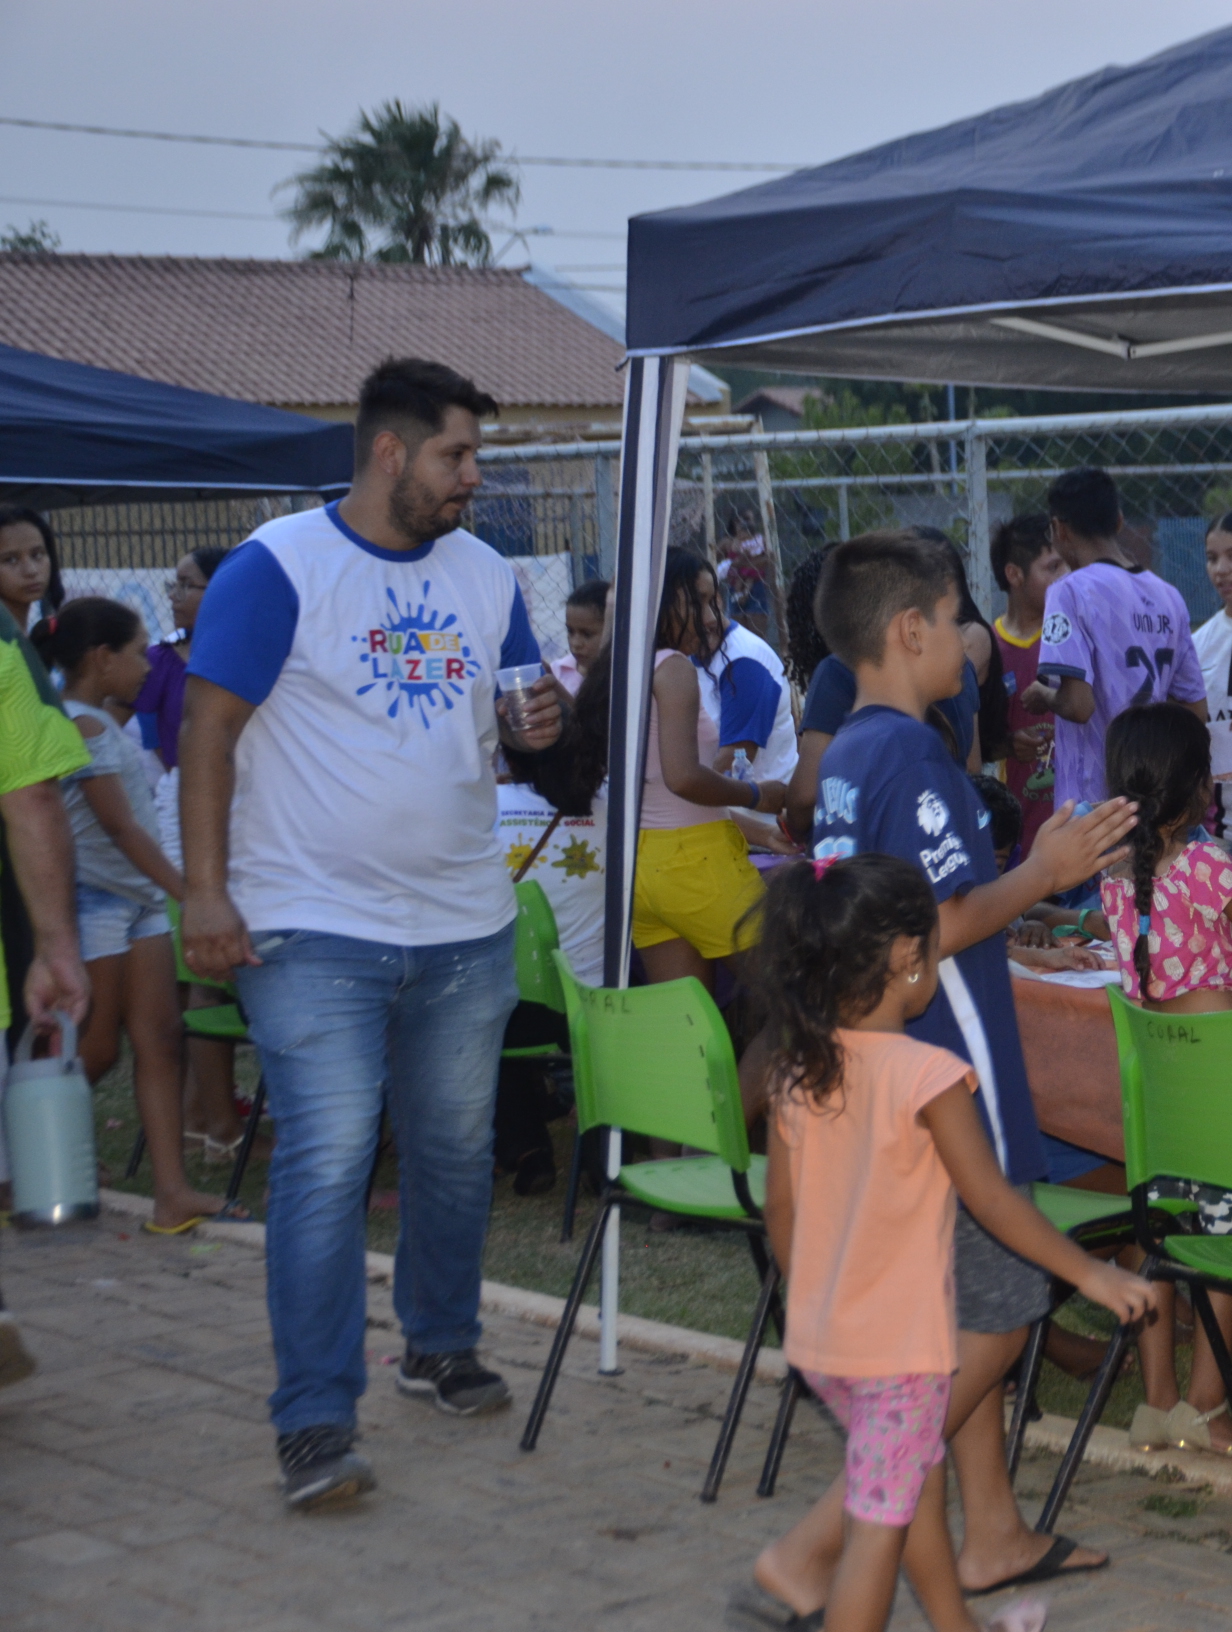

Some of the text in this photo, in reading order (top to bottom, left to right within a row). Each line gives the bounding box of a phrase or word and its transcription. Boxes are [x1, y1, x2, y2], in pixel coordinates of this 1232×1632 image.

[369, 629, 458, 655] RUA DE
[372, 657, 465, 681] LAZER
